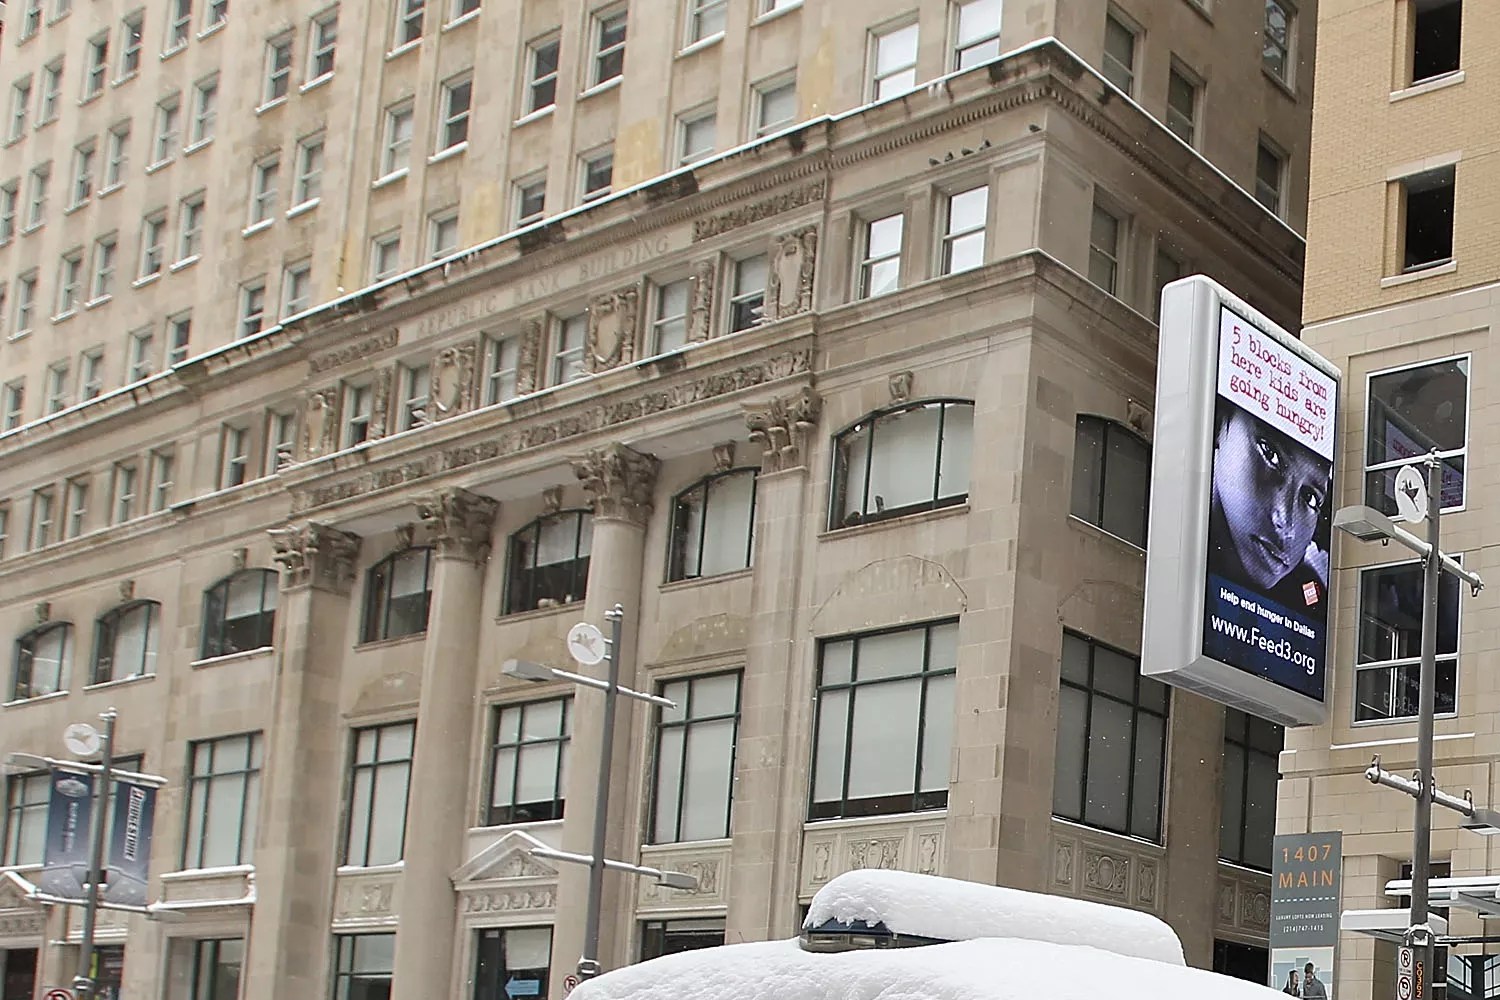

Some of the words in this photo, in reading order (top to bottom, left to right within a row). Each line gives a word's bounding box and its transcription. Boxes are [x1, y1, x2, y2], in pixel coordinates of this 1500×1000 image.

[579, 235, 669, 281] BUILDING
[1231, 346, 1262, 379] here
[1269, 370, 1299, 402] kids
[1305, 398, 1326, 420] are
[1233, 325, 1241, 344] 5
[1249, 333, 1292, 376] blocks
[1299, 370, 1327, 401] from
[1230, 374, 1270, 411] going
[1276, 397, 1325, 442] hungry!
[1220, 587, 1239, 606] Help
[1240, 598, 1256, 613] end
[1257, 604, 1284, 625] hunger
[1284, 616, 1293, 629] in
[1293, 621, 1316, 639] Dallas
[1211, 615, 1316, 675] www.Feed3.org
[1279, 869, 1334, 889] MAIN
[1282, 844, 1331, 864] 1407
